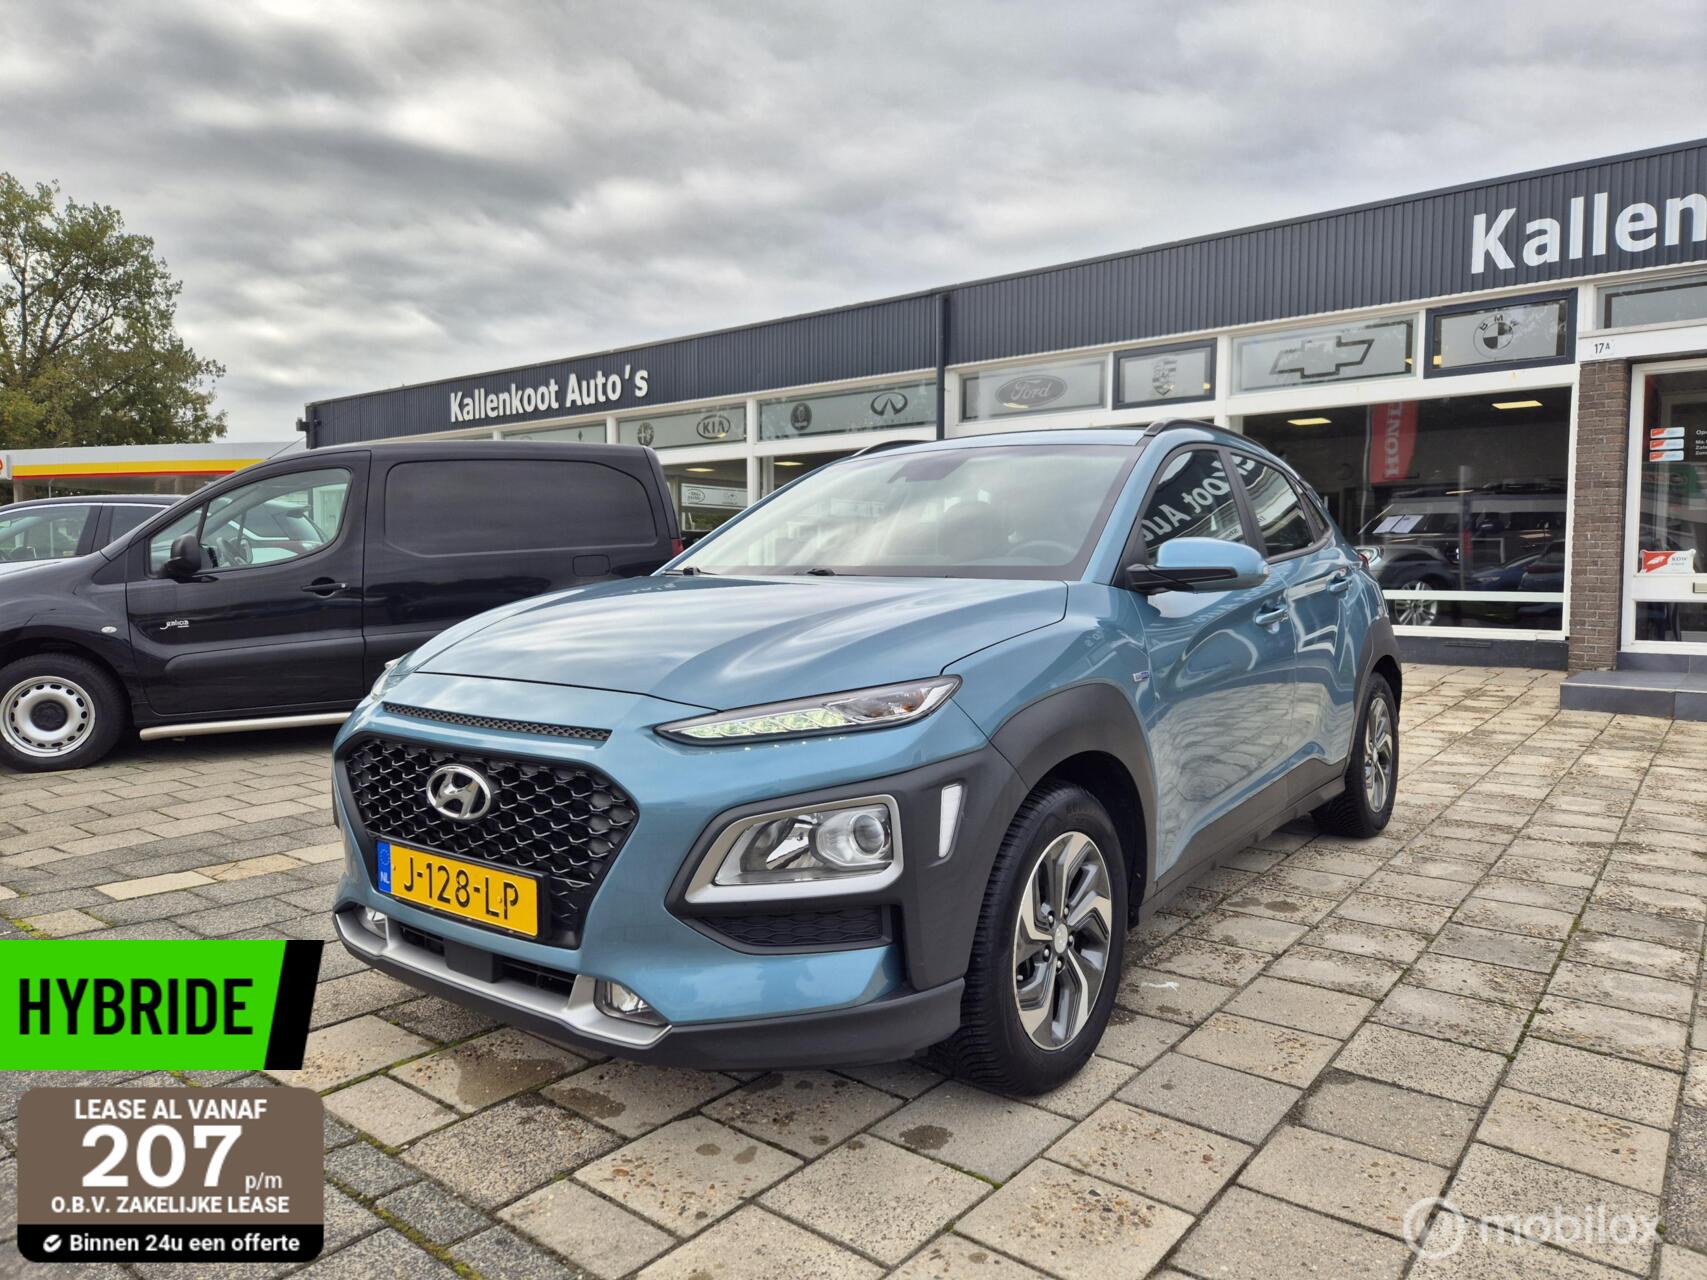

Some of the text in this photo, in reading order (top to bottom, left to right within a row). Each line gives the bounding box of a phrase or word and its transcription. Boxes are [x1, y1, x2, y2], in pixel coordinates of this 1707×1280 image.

[1471, 192, 1707, 274] Kallen
[450, 364, 649, 422] Kallenkoot Auto's
[1011, 380, 1053, 400] Ford
[702, 420, 726, 434] KIA
[380, 871, 390, 885] NL
[404, 857, 519, 920] J-128-LP
